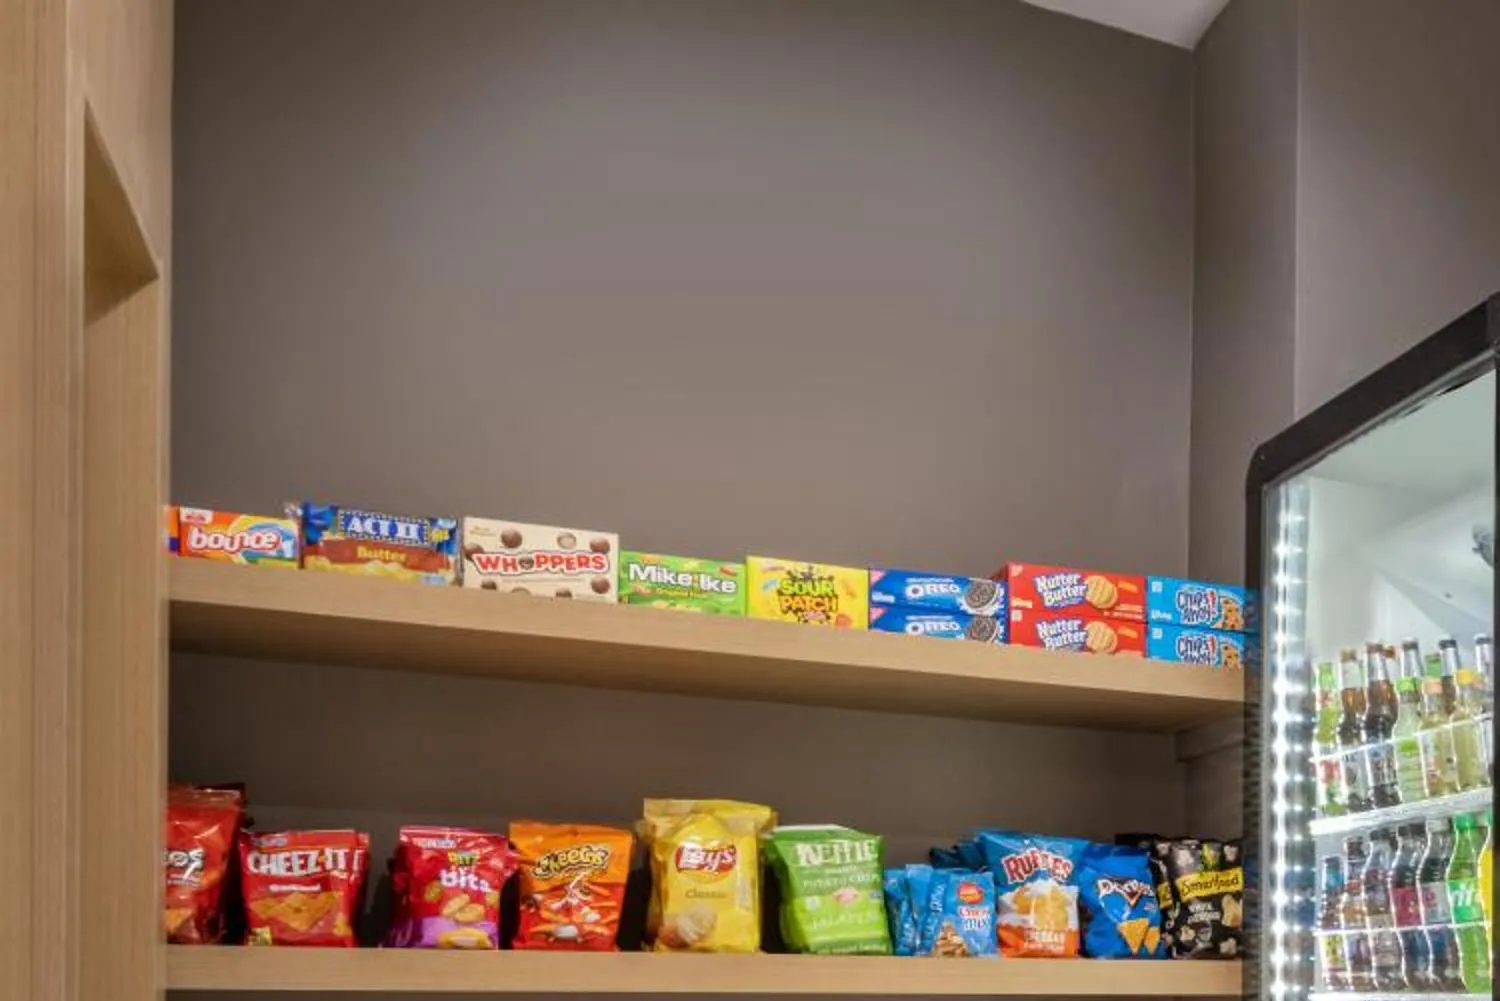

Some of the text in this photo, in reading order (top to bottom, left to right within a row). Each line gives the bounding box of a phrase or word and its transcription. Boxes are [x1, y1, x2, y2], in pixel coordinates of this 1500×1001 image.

[347, 515, 393, 538] ACT
[356, 545, 407, 562] Butter
[628, 563, 693, 587] Mike
[699, 574, 738, 594] Ike
[779, 578, 836, 597] SOUR
